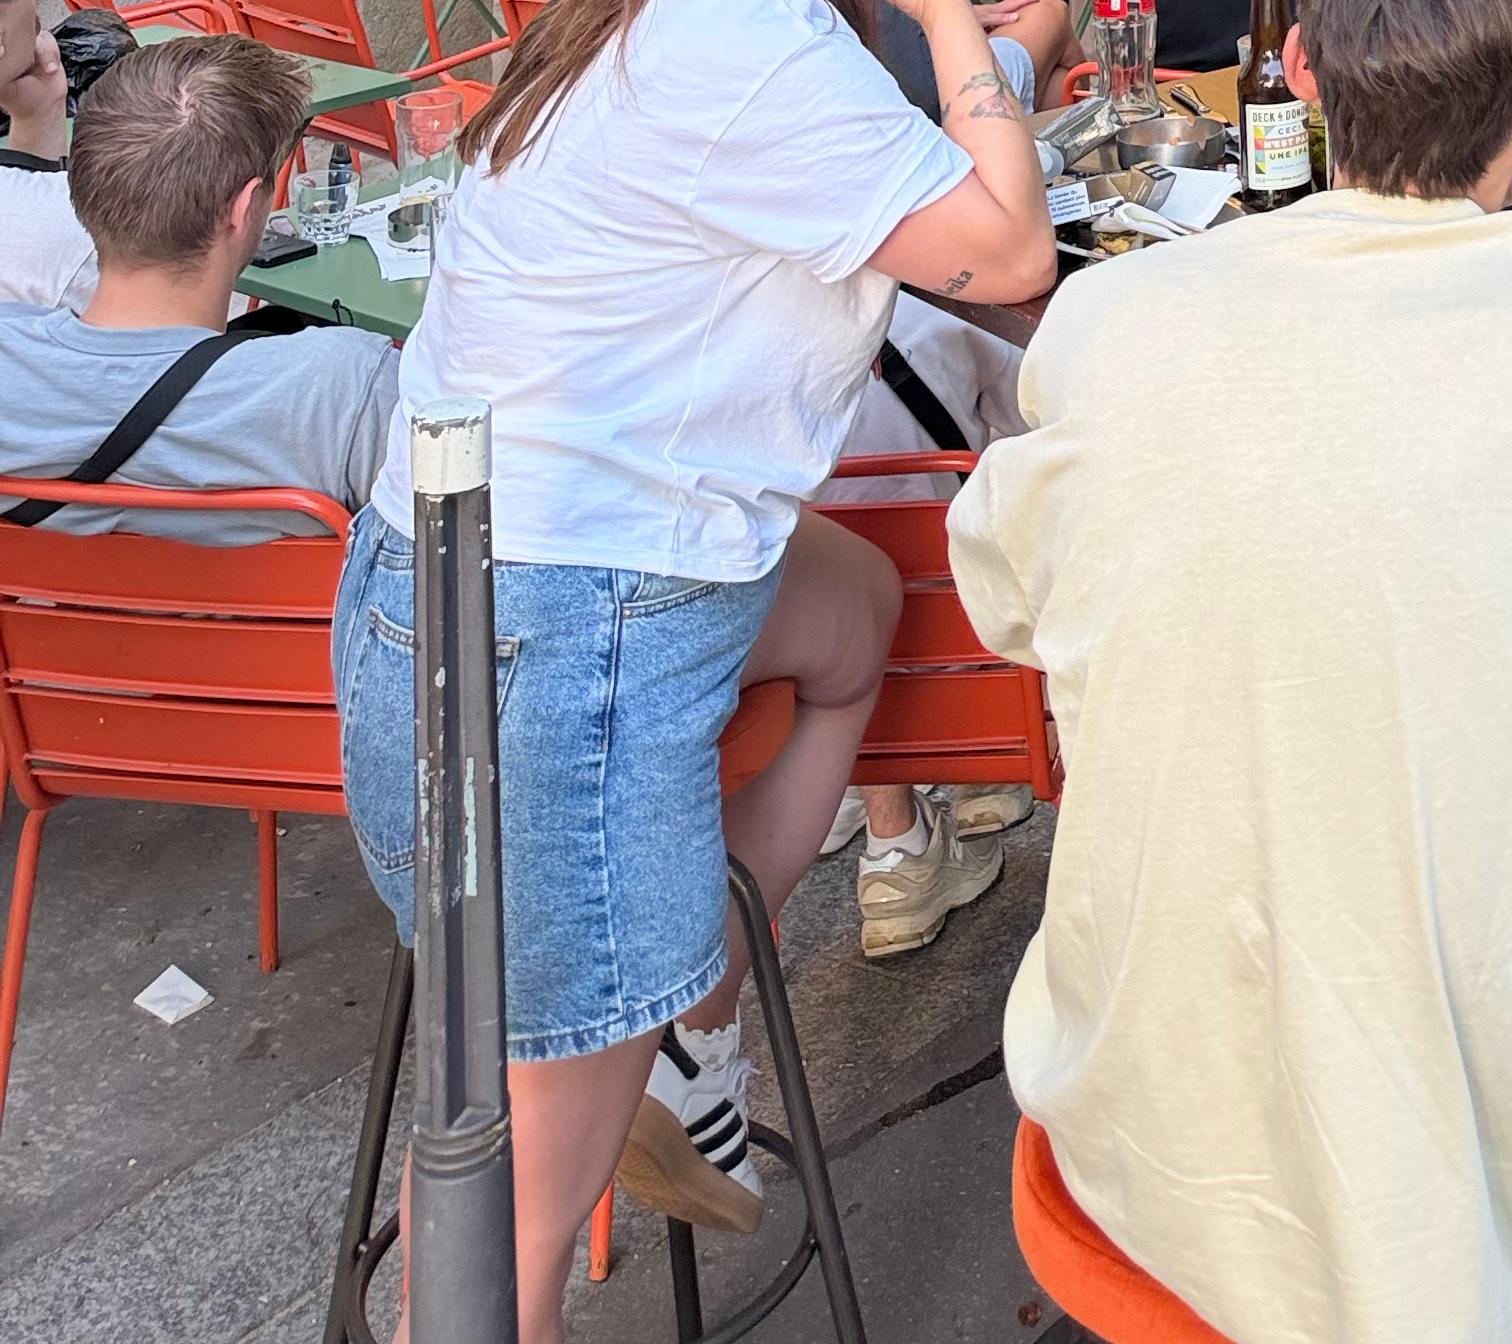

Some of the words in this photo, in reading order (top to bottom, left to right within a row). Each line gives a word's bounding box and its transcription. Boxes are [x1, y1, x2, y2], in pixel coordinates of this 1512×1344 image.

[1252, 112, 1276, 123] DECK
[1277, 125, 1301, 135] CECI
[1269, 152, 1292, 160] UNE
[1295, 146, 1308, 157] IPA
